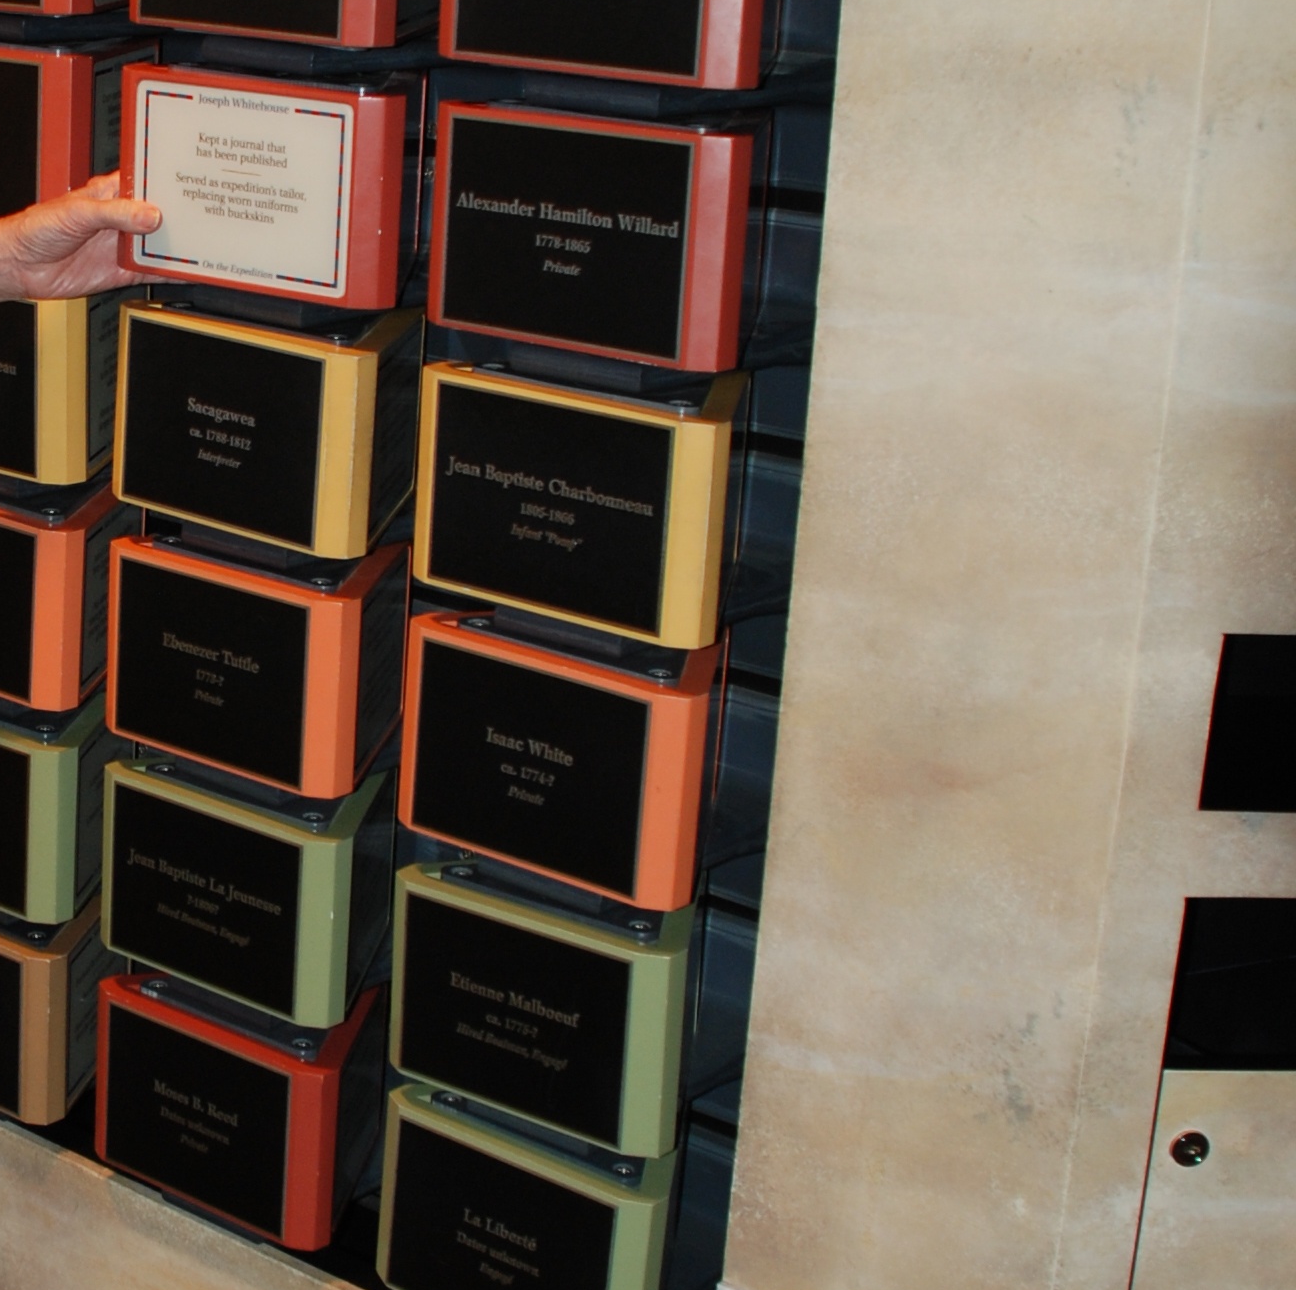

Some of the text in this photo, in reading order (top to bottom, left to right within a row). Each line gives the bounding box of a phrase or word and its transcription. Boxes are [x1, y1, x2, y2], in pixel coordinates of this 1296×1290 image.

[198, 93, 291, 115] Joseph Whitehouse
[198, 132, 287, 155] Kept a journal that
[196, 145, 288, 169] has been published
[175, 171, 308, 202] Served as expedition's tailor,
[182, 187, 300, 214] replacing worn uniforms
[204, 204, 275, 225] with buckskins
[456, 192, 680, 240] Alexander Hamilton Willard
[535, 234, 592, 255] 1778-1865
[202, 259, 274, 280] On the Expedition
[542, 259, 583, 277] Private
[187, 396, 256, 428] Sacagawea
[189, 426, 252, 451] ca. 1788-1812
[197, 448, 242, 469] Interpreter
[446, 456, 654, 518] Jean Baptiste Charbonneau
[519, 502, 576, 526] 1805-1866
[510, 523, 543, 542] Infant
[162, 631, 261, 674] Ebenezer Tuttle
[486, 725, 575, 767] Isaac White
[500, 762, 518, 776] ca.
[507, 785, 546, 806] Private
[127, 848, 282, 916] Jean Baptiste La Jeunesse
[449, 970, 581, 1028] Etienne Malboeuf
[486, 1012, 502, 1027] ca.
[154, 1078, 239, 1128] Moses B. Reed
[463, 1207, 482, 1228] La
[456, 1230, 540, 1278] Dates unknown
